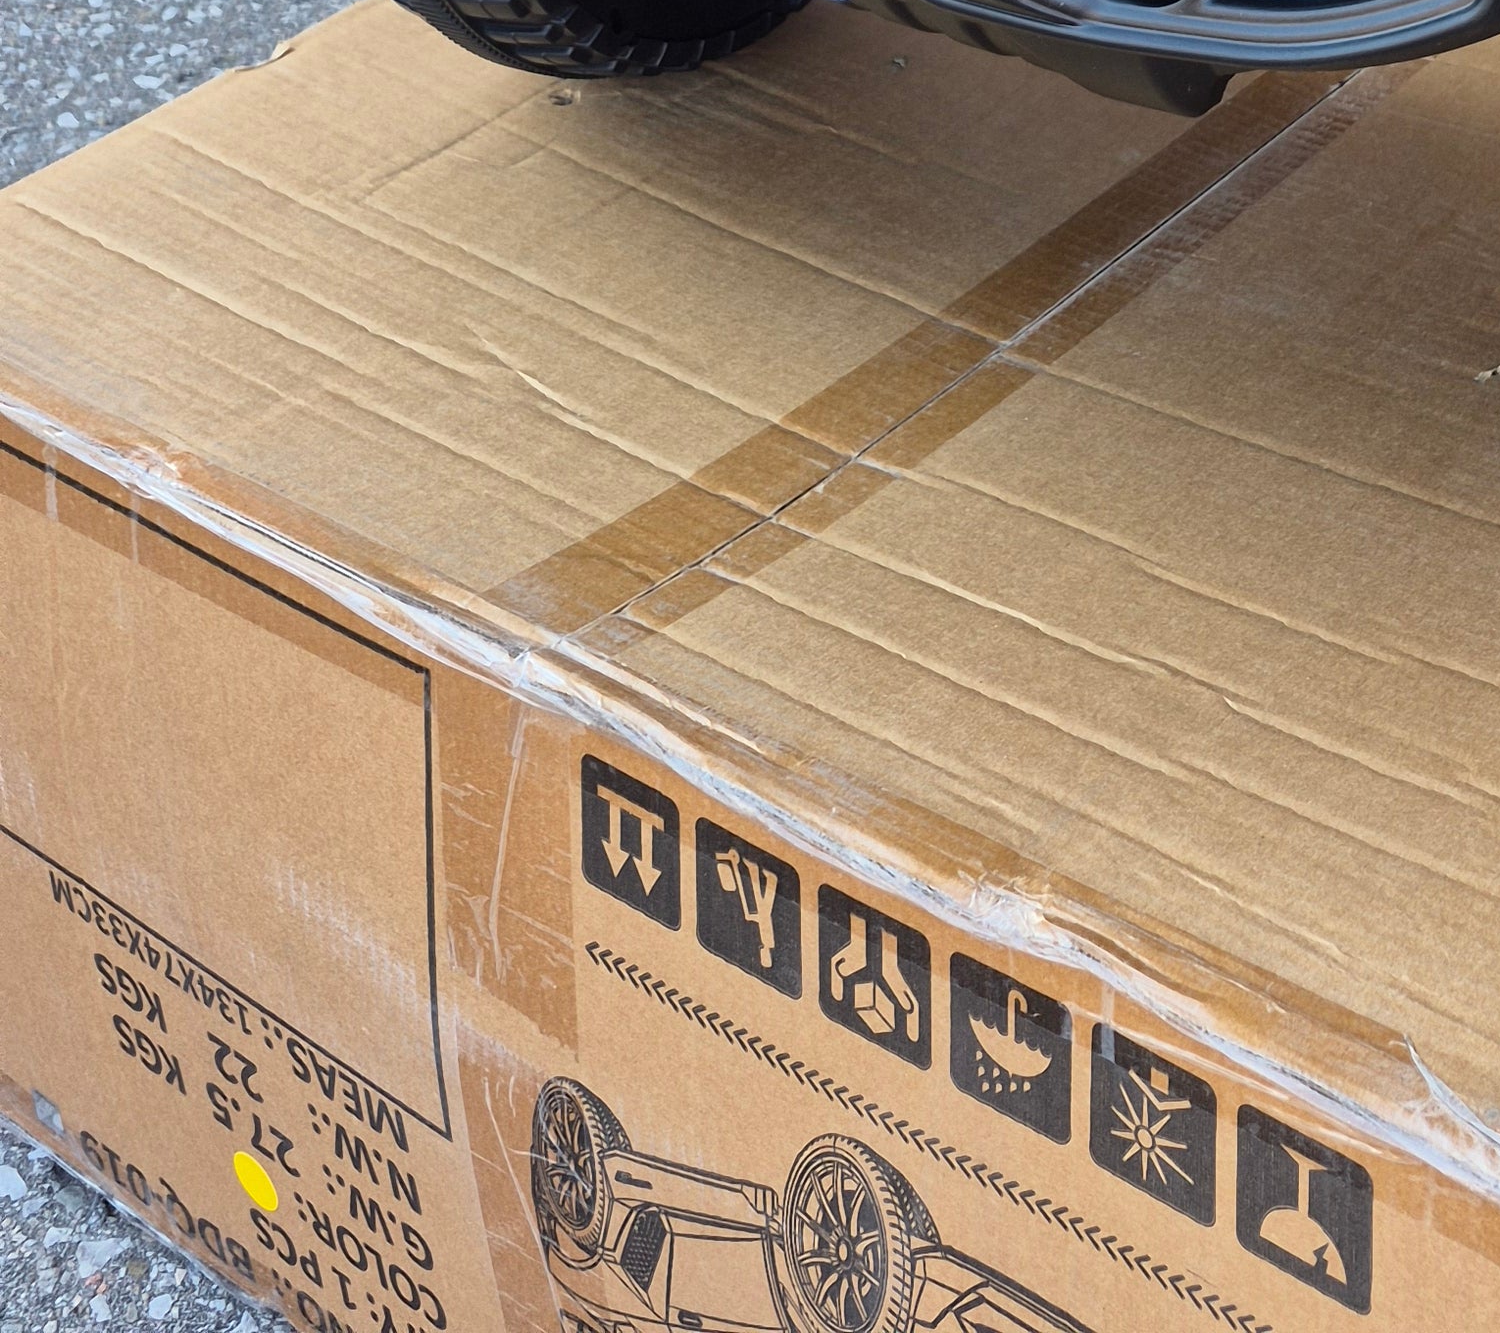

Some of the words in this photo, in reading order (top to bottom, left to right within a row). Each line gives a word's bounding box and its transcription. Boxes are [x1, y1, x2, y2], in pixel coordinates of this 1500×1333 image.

[94, 952, 168, 1034] KGS
[112, 1014, 188, 1096] KGS
[207, 1031, 264, 1104] 22
[80, 1130, 257, 1282] BDQ-019
[249, 1207, 324, 1289] PCS
[293, 1190, 447, 1331] COLOR:
